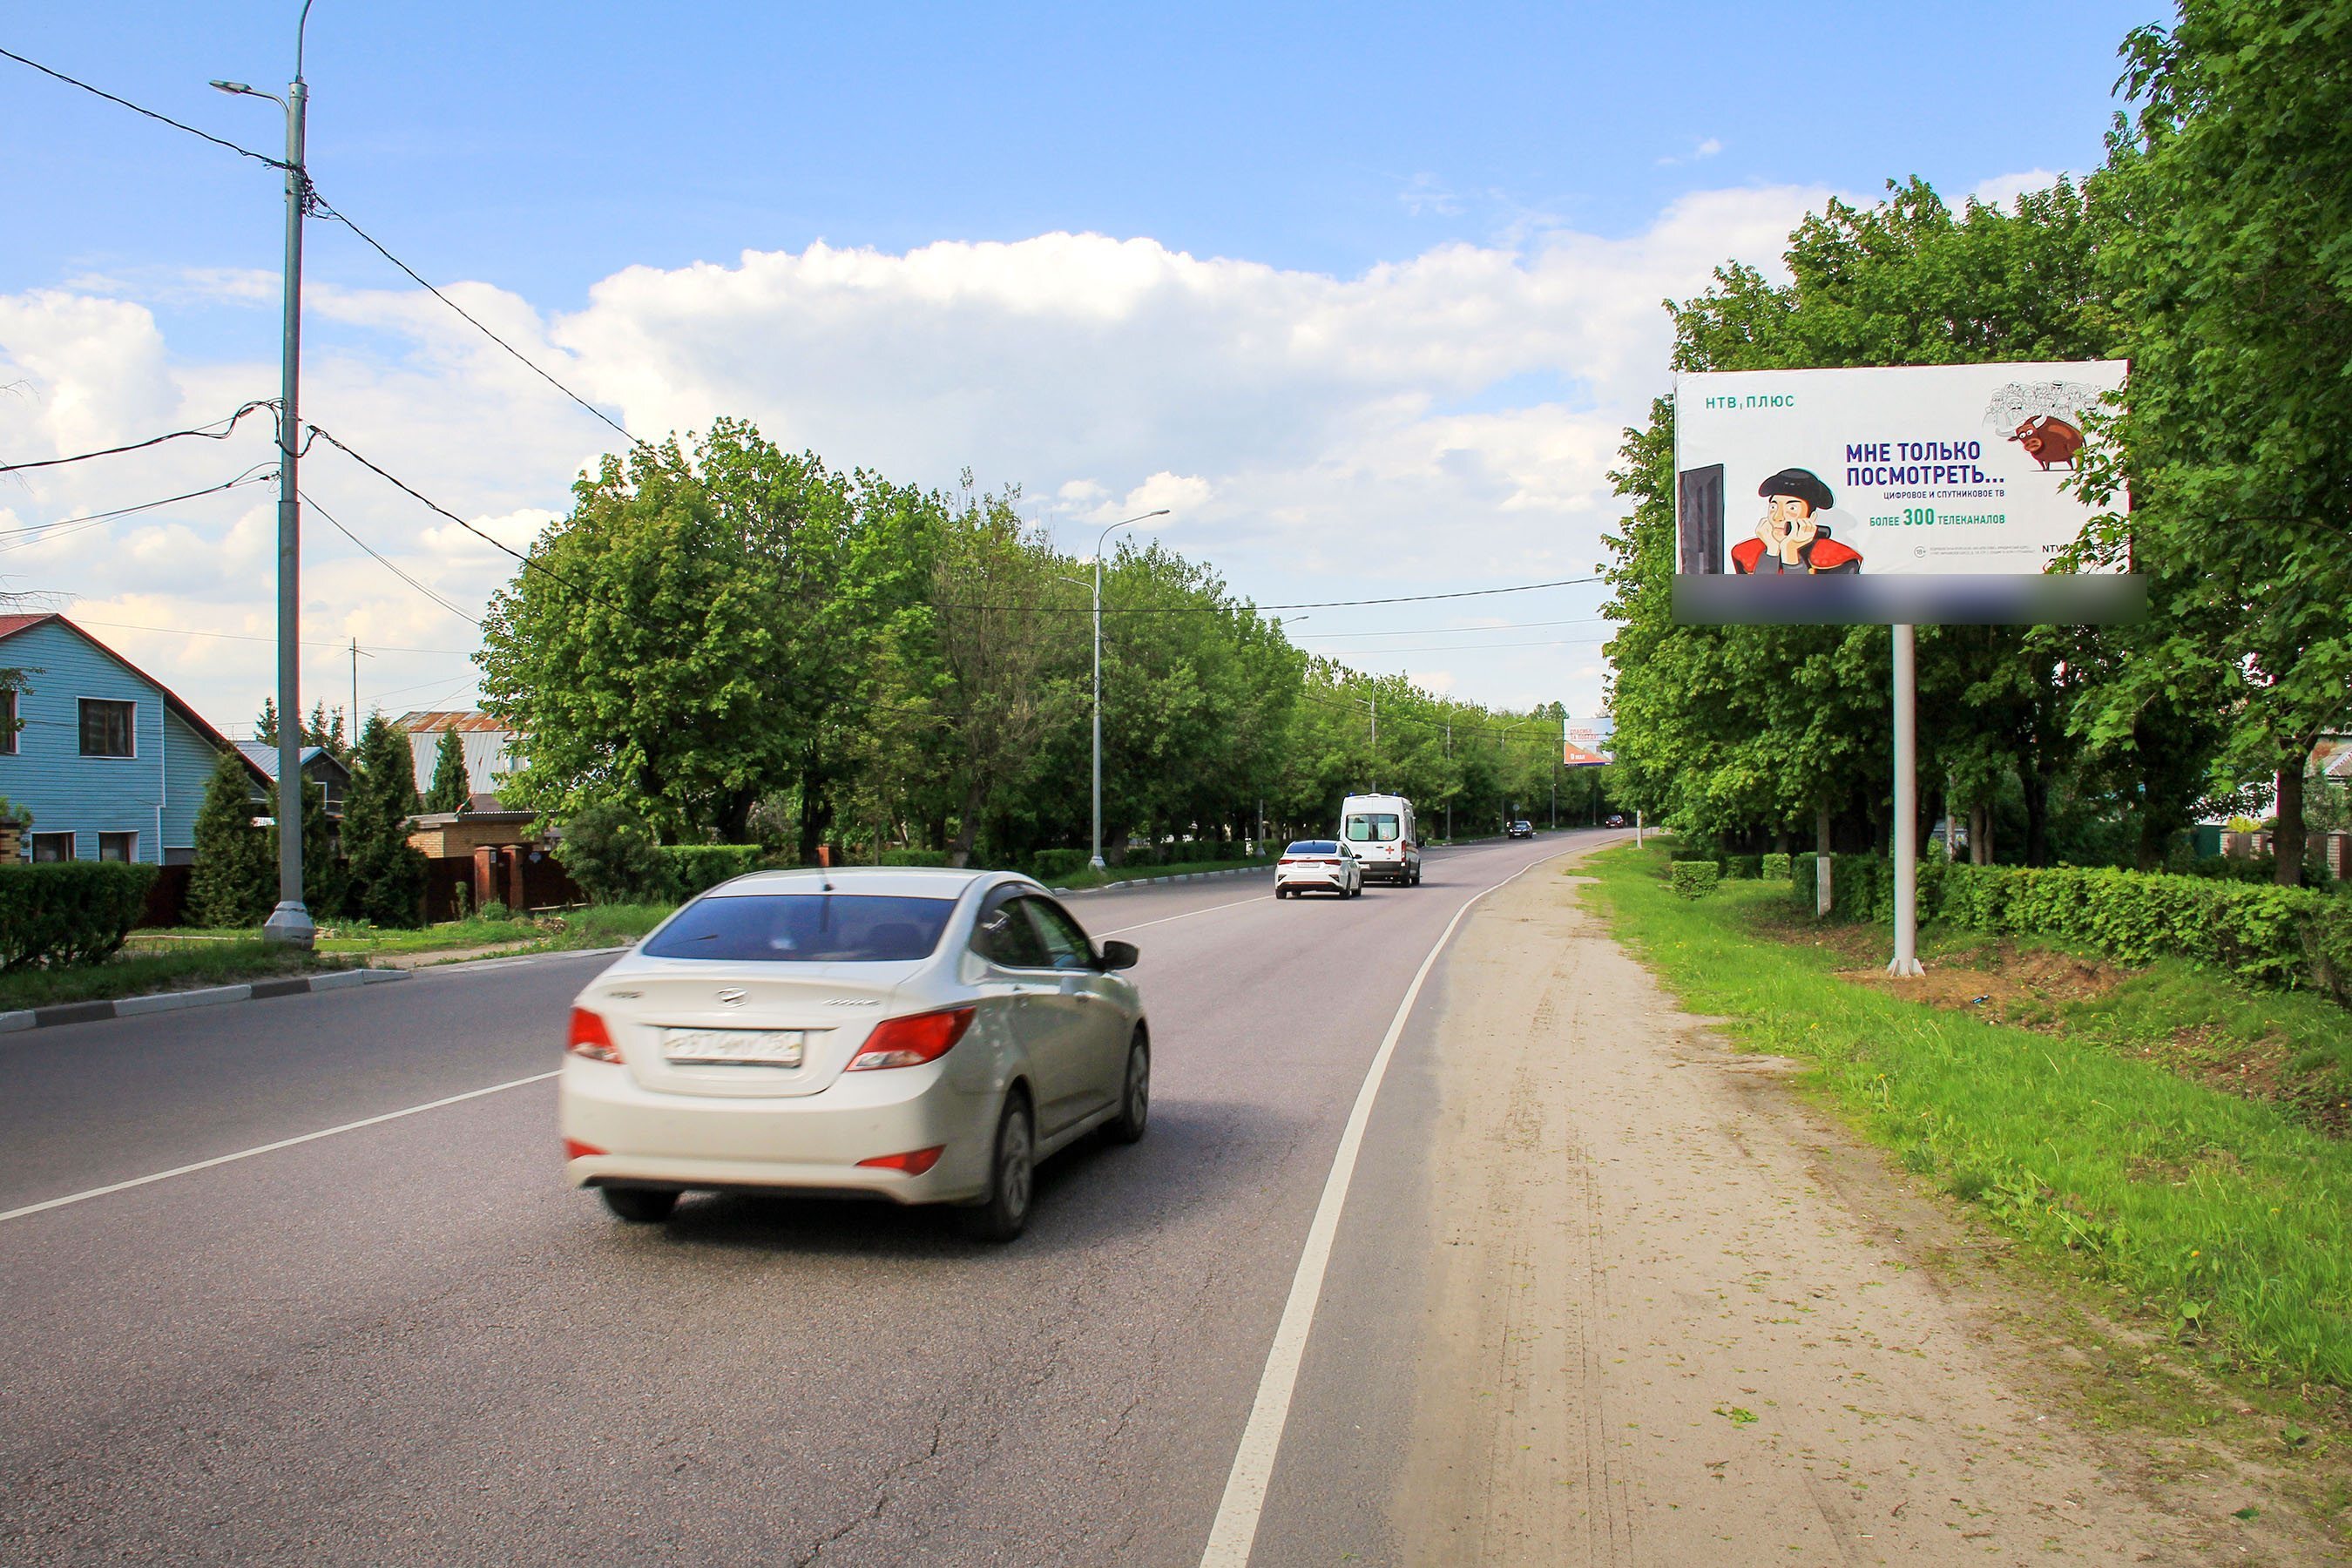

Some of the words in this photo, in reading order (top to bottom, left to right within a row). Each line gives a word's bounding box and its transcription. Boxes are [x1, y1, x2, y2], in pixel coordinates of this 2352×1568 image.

[1846, 443, 1891, 463] МНЕ
[1897, 440, 1981, 462] ТОЛЬКО
[1846, 464, 2004, 487] ПОСМОТРЕТЬ...
[1883, 490, 1927, 500] ЦИФРОВОЕ
[1936, 490, 1993, 499] СПУТНИКОВОЕ
[1995, 489, 2005, 497] ТВ
[1869, 516, 1900, 527] БОЛЕЕ
[1903, 508, 1935, 526] 300
[1937, 514, 2005, 525] ТЕЛЕКАНАЛОВ
